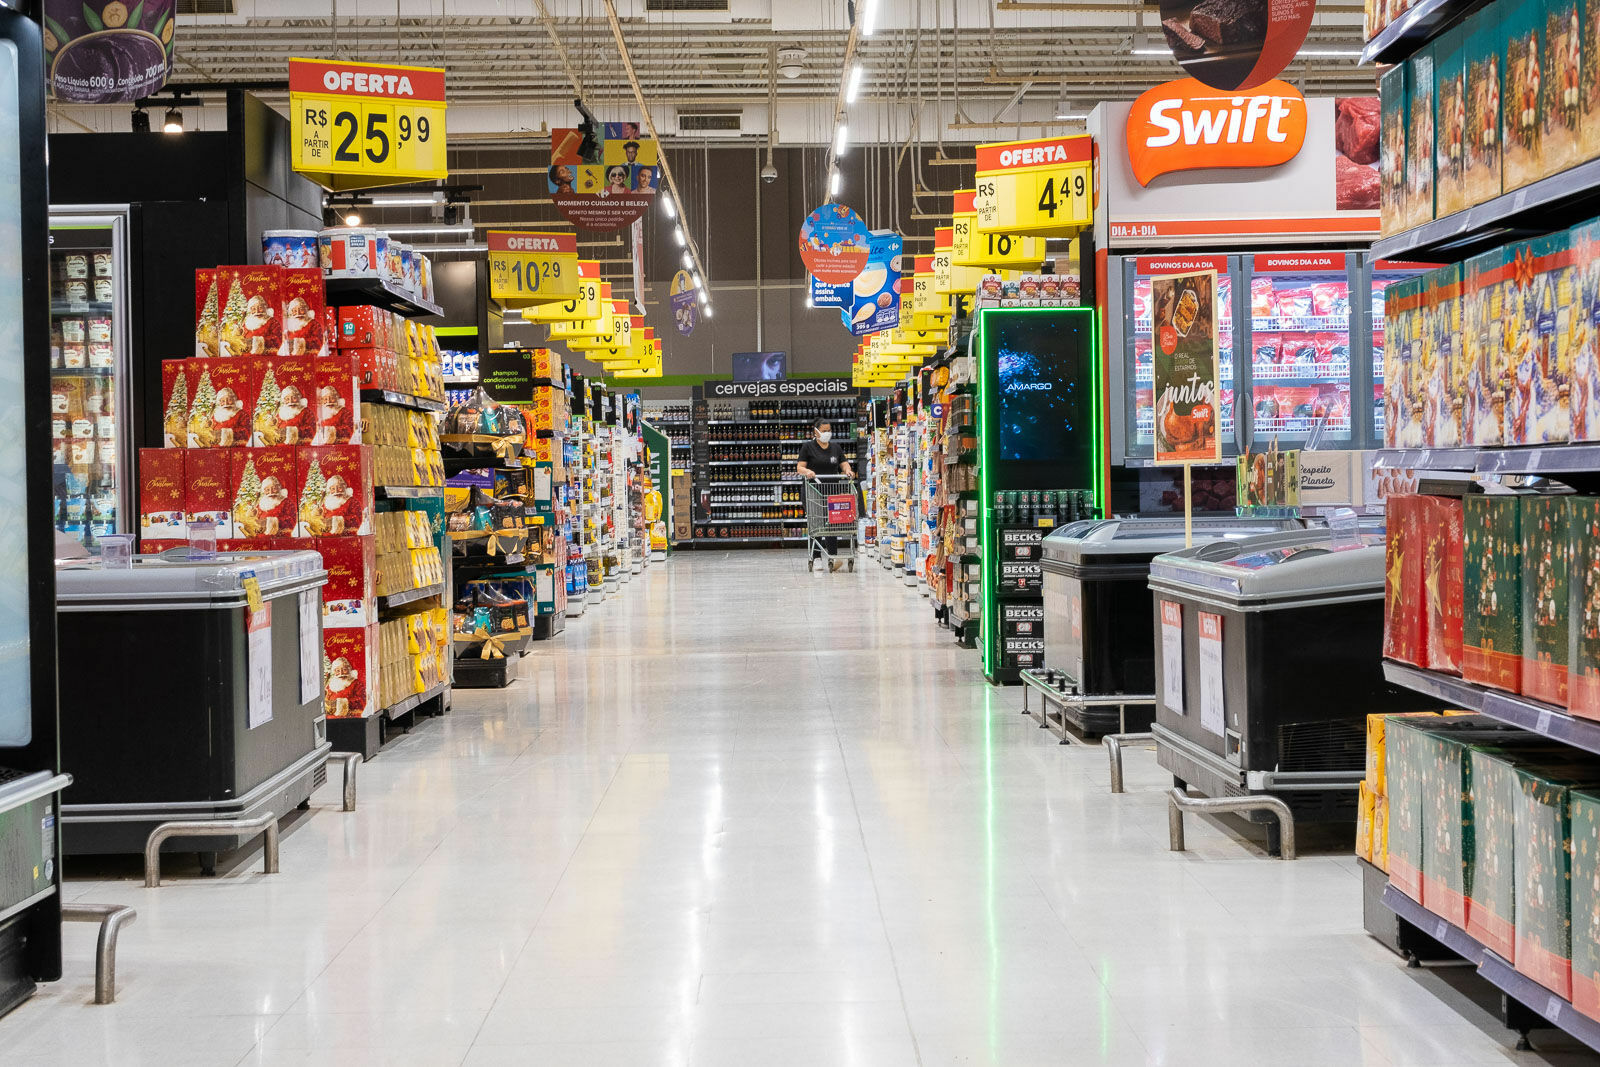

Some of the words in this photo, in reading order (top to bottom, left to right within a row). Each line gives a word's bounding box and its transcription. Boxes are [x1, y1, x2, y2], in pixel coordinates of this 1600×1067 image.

[90, 76, 107, 88] 600
[108, 77, 114, 89] g
[145, 64, 157, 78] 700
[323, 71, 414, 95] OFERTA
[305, 109, 328, 128] R$
[1146, 96, 1291, 147] Swift
[314, 130, 319, 139] A
[304, 139, 329, 149] PARTIR
[312, 149, 322, 158] DE
[1000, 145, 1067, 166] OFERTA
[979, 183, 995, 198] R$
[978, 205, 997, 214] PARTIR
[955, 223, 969, 235] R$
[1111, 225, 1158, 236] DIA-A-DIA
[507, 237, 559, 250] OFERTA
[493, 260, 507, 272] R$
[936, 257, 949, 267] R$
[915, 281, 927, 291] R$
[902, 301, 913, 309] R$
[715, 381, 776, 396] cervejas
[779, 379, 848, 395] especiais
[1007, 382, 1052, 391] AMARGO
[1157, 371, 1215, 417] juntos
[1192, 408, 1209, 419] Swift
[1004, 532, 1042, 542] BECK'S
[1003, 565, 1041, 573] BECK'S
[1005, 608, 1044, 617] BECK'S
[326, 635, 354, 648] Christmas
[1006, 641, 1044, 649] BECK'S
